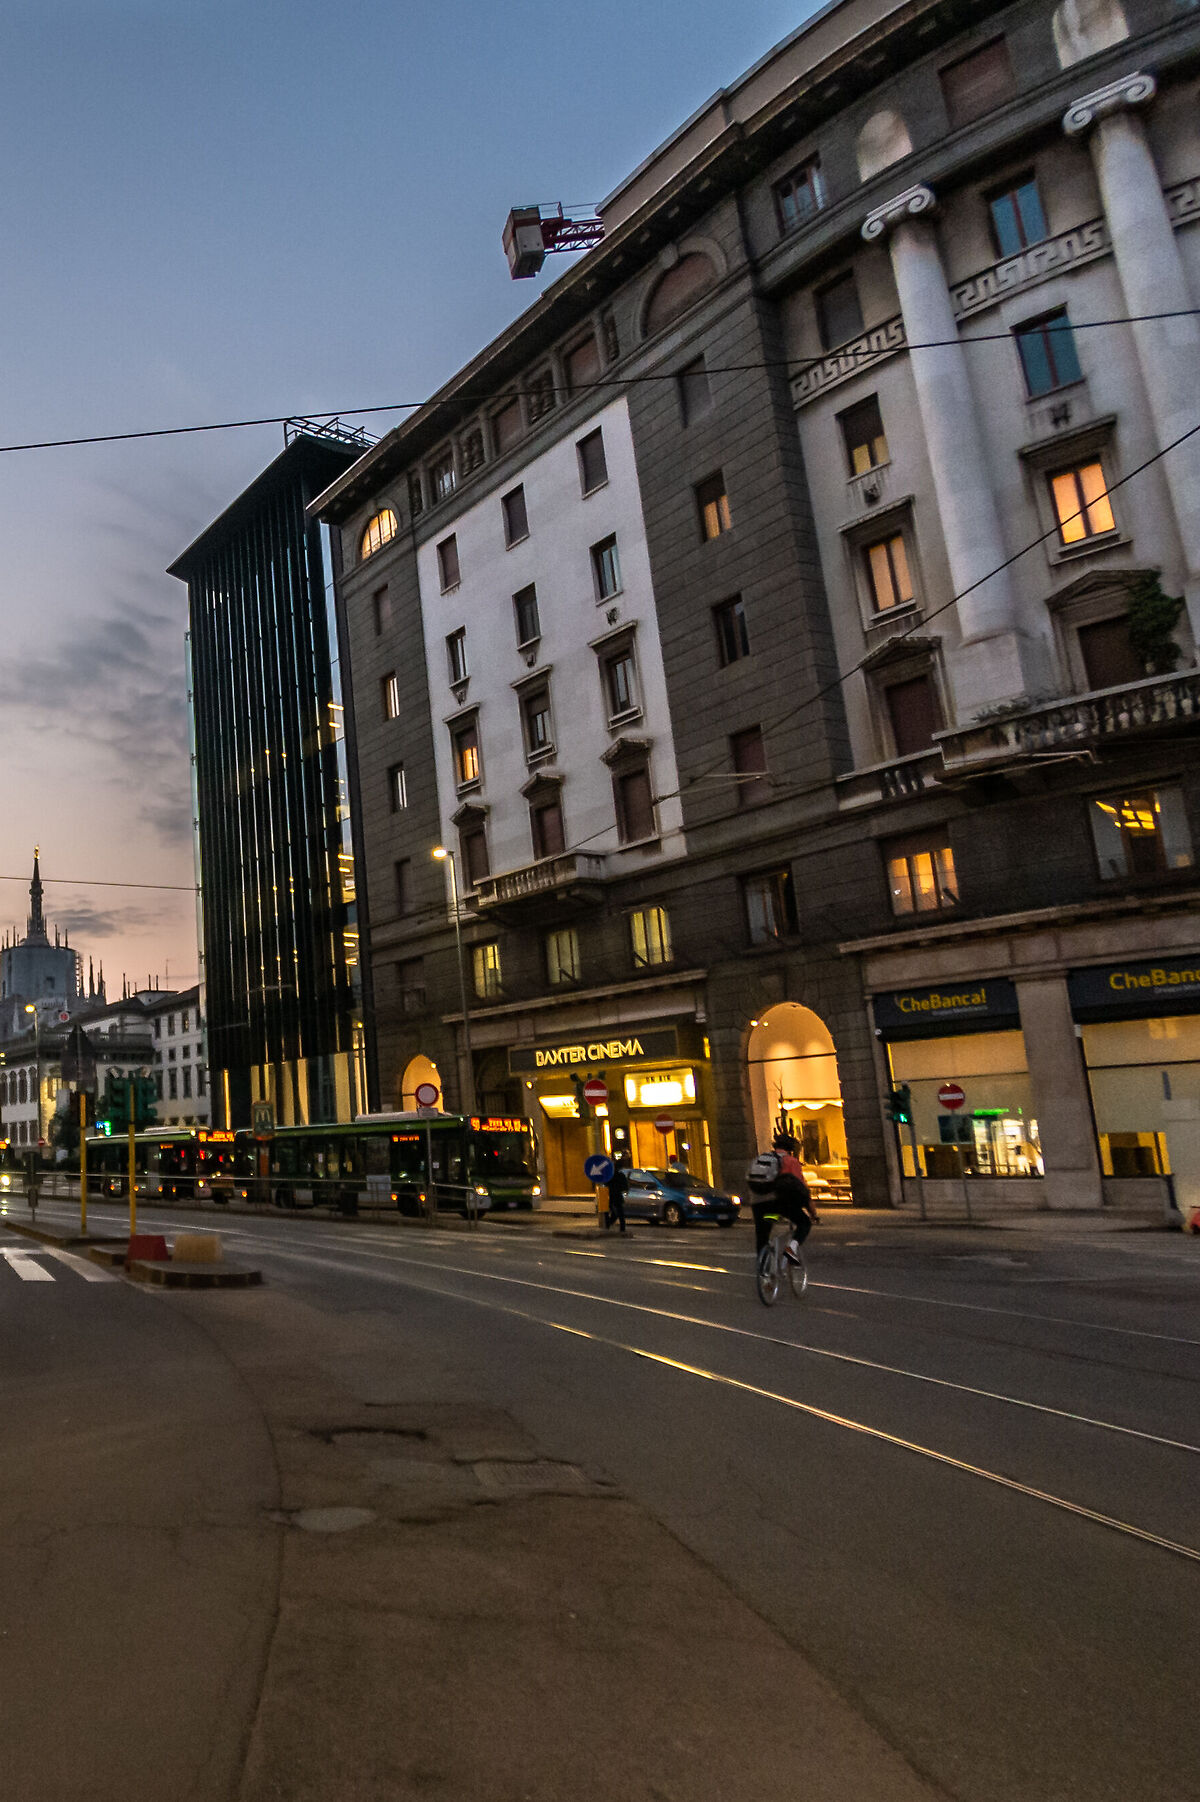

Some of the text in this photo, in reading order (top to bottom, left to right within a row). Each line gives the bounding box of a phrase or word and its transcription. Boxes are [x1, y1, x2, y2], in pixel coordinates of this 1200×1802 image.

[900, 988, 987, 1012] CheBanca!
[535, 1038, 645, 1067] BAXTER CINEMA
